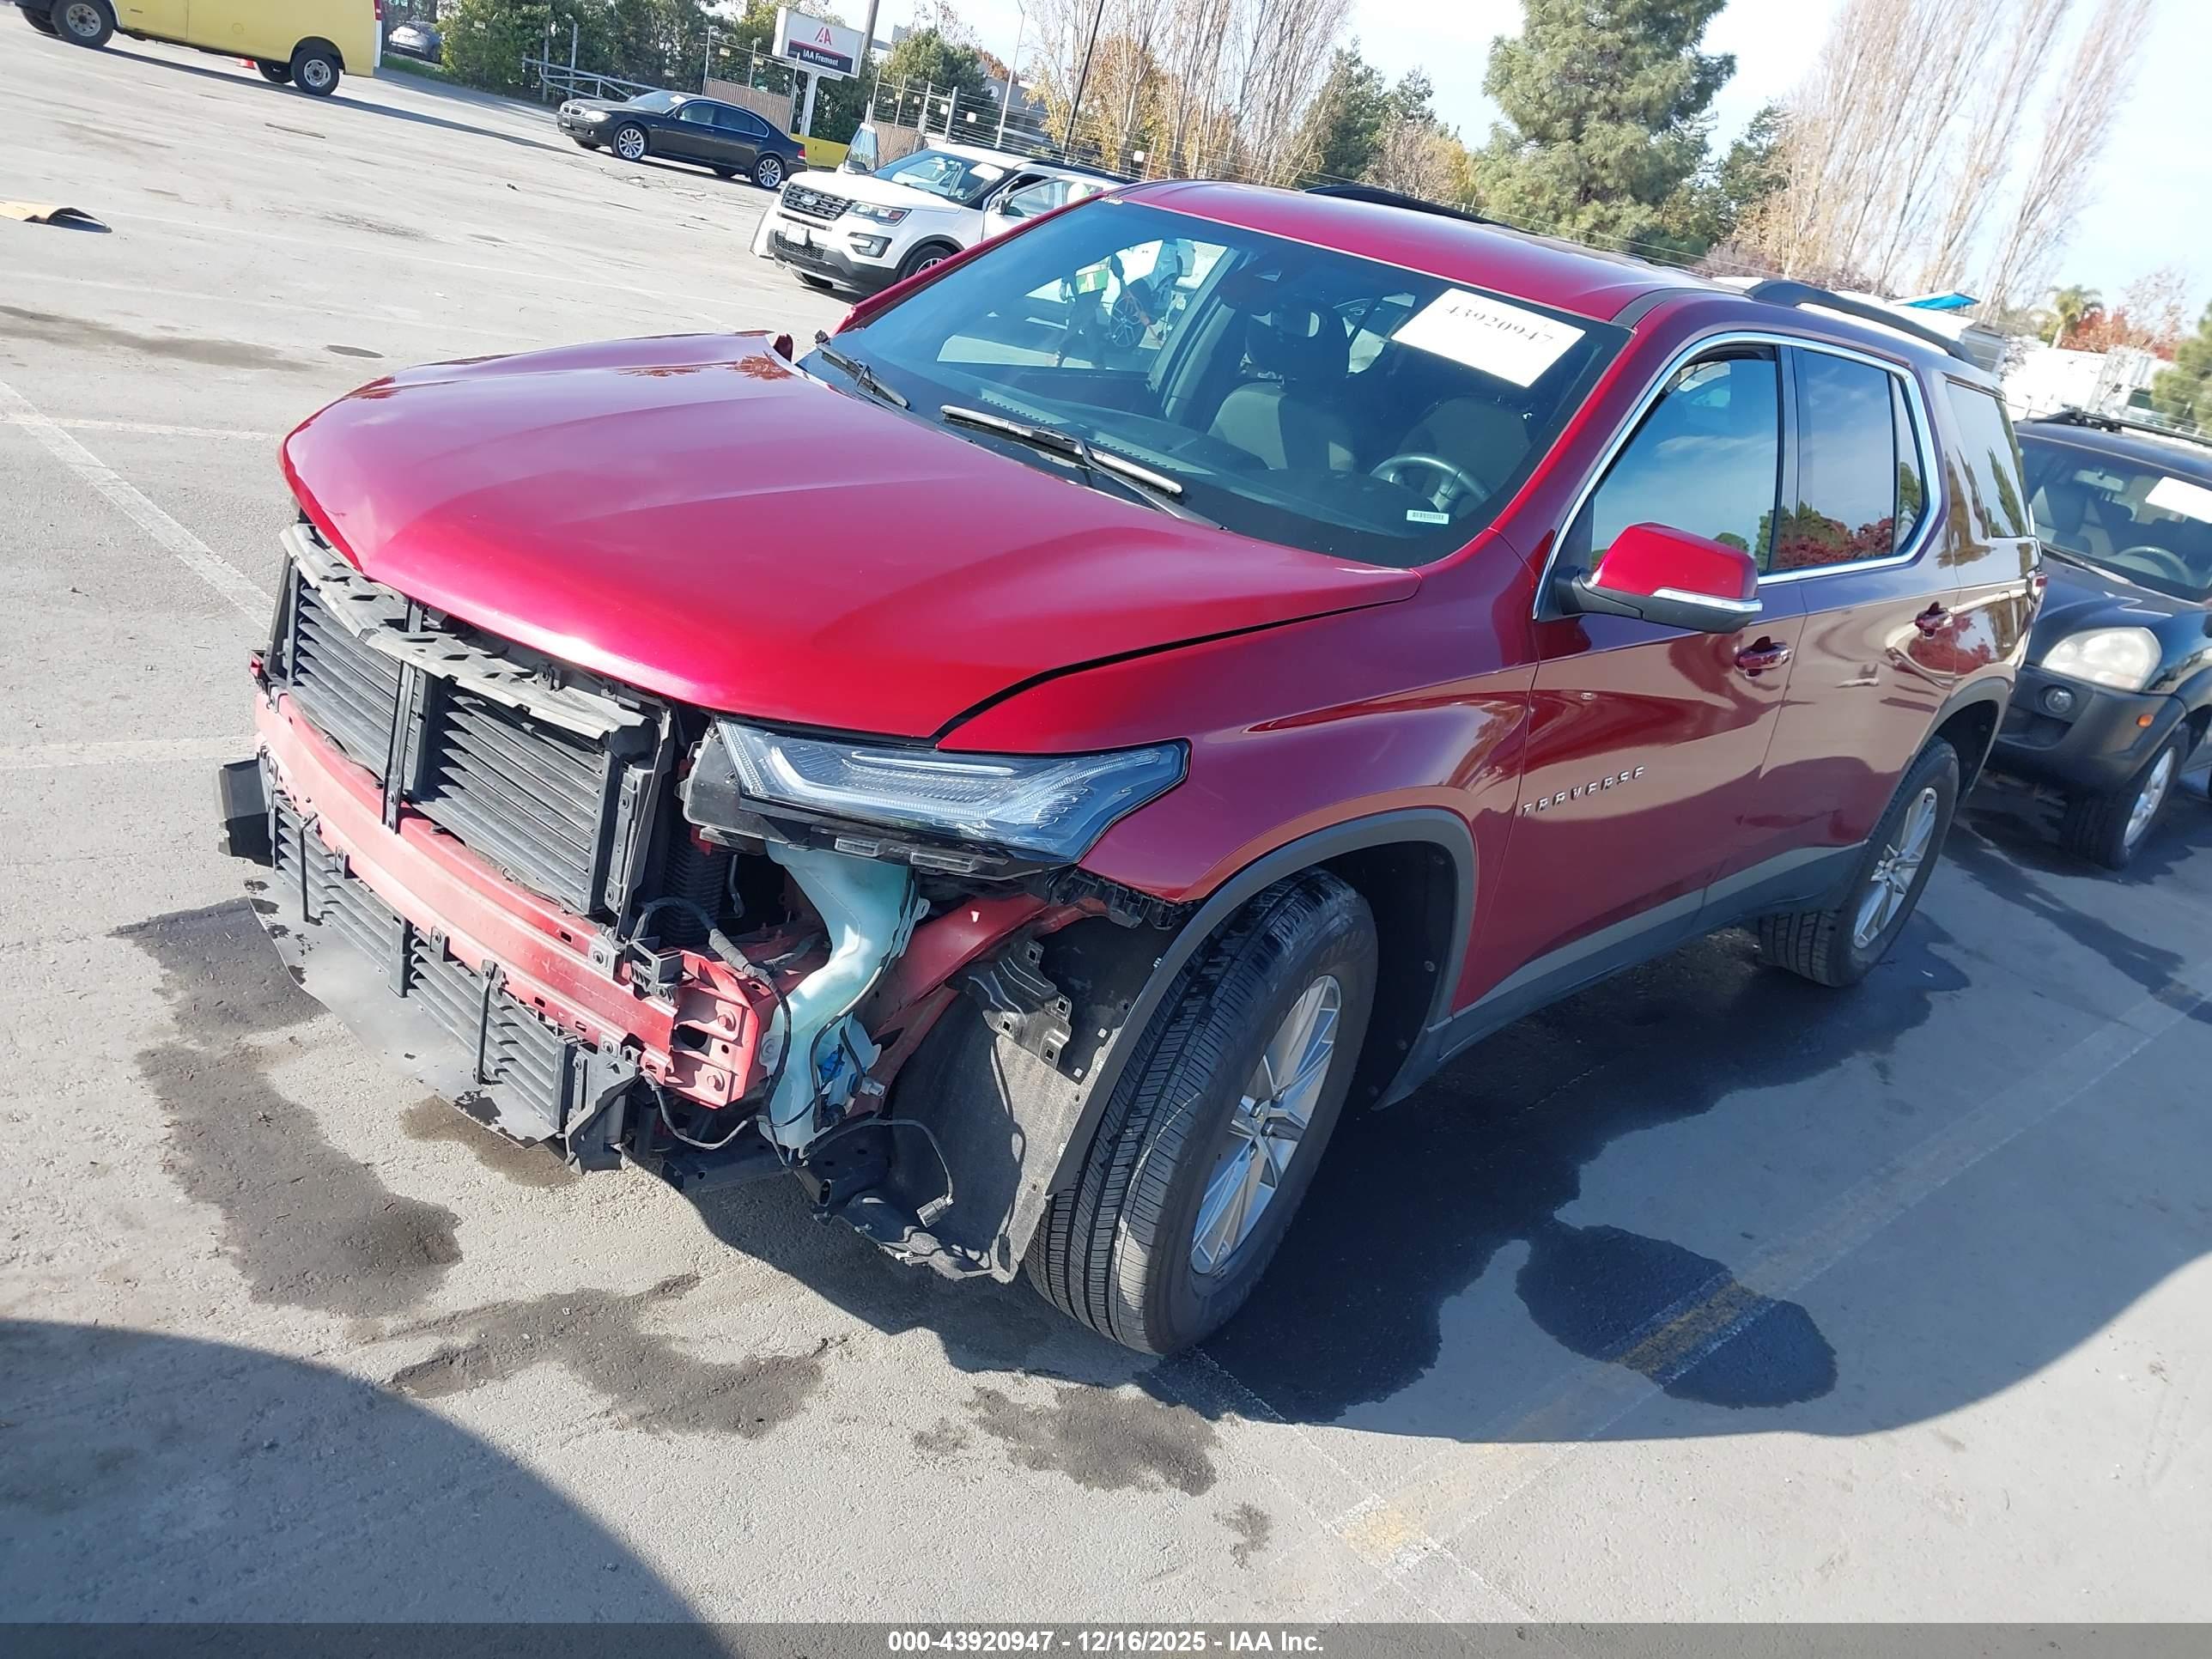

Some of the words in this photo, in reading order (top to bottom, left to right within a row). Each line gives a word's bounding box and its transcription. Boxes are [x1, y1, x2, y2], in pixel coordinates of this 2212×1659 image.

[803, 49, 814, 61] IAA
[815, 52, 839, 67] Fremont
[1445, 305, 1554, 344] 43920947
[1522, 766, 1644, 817] TRAVERSE
